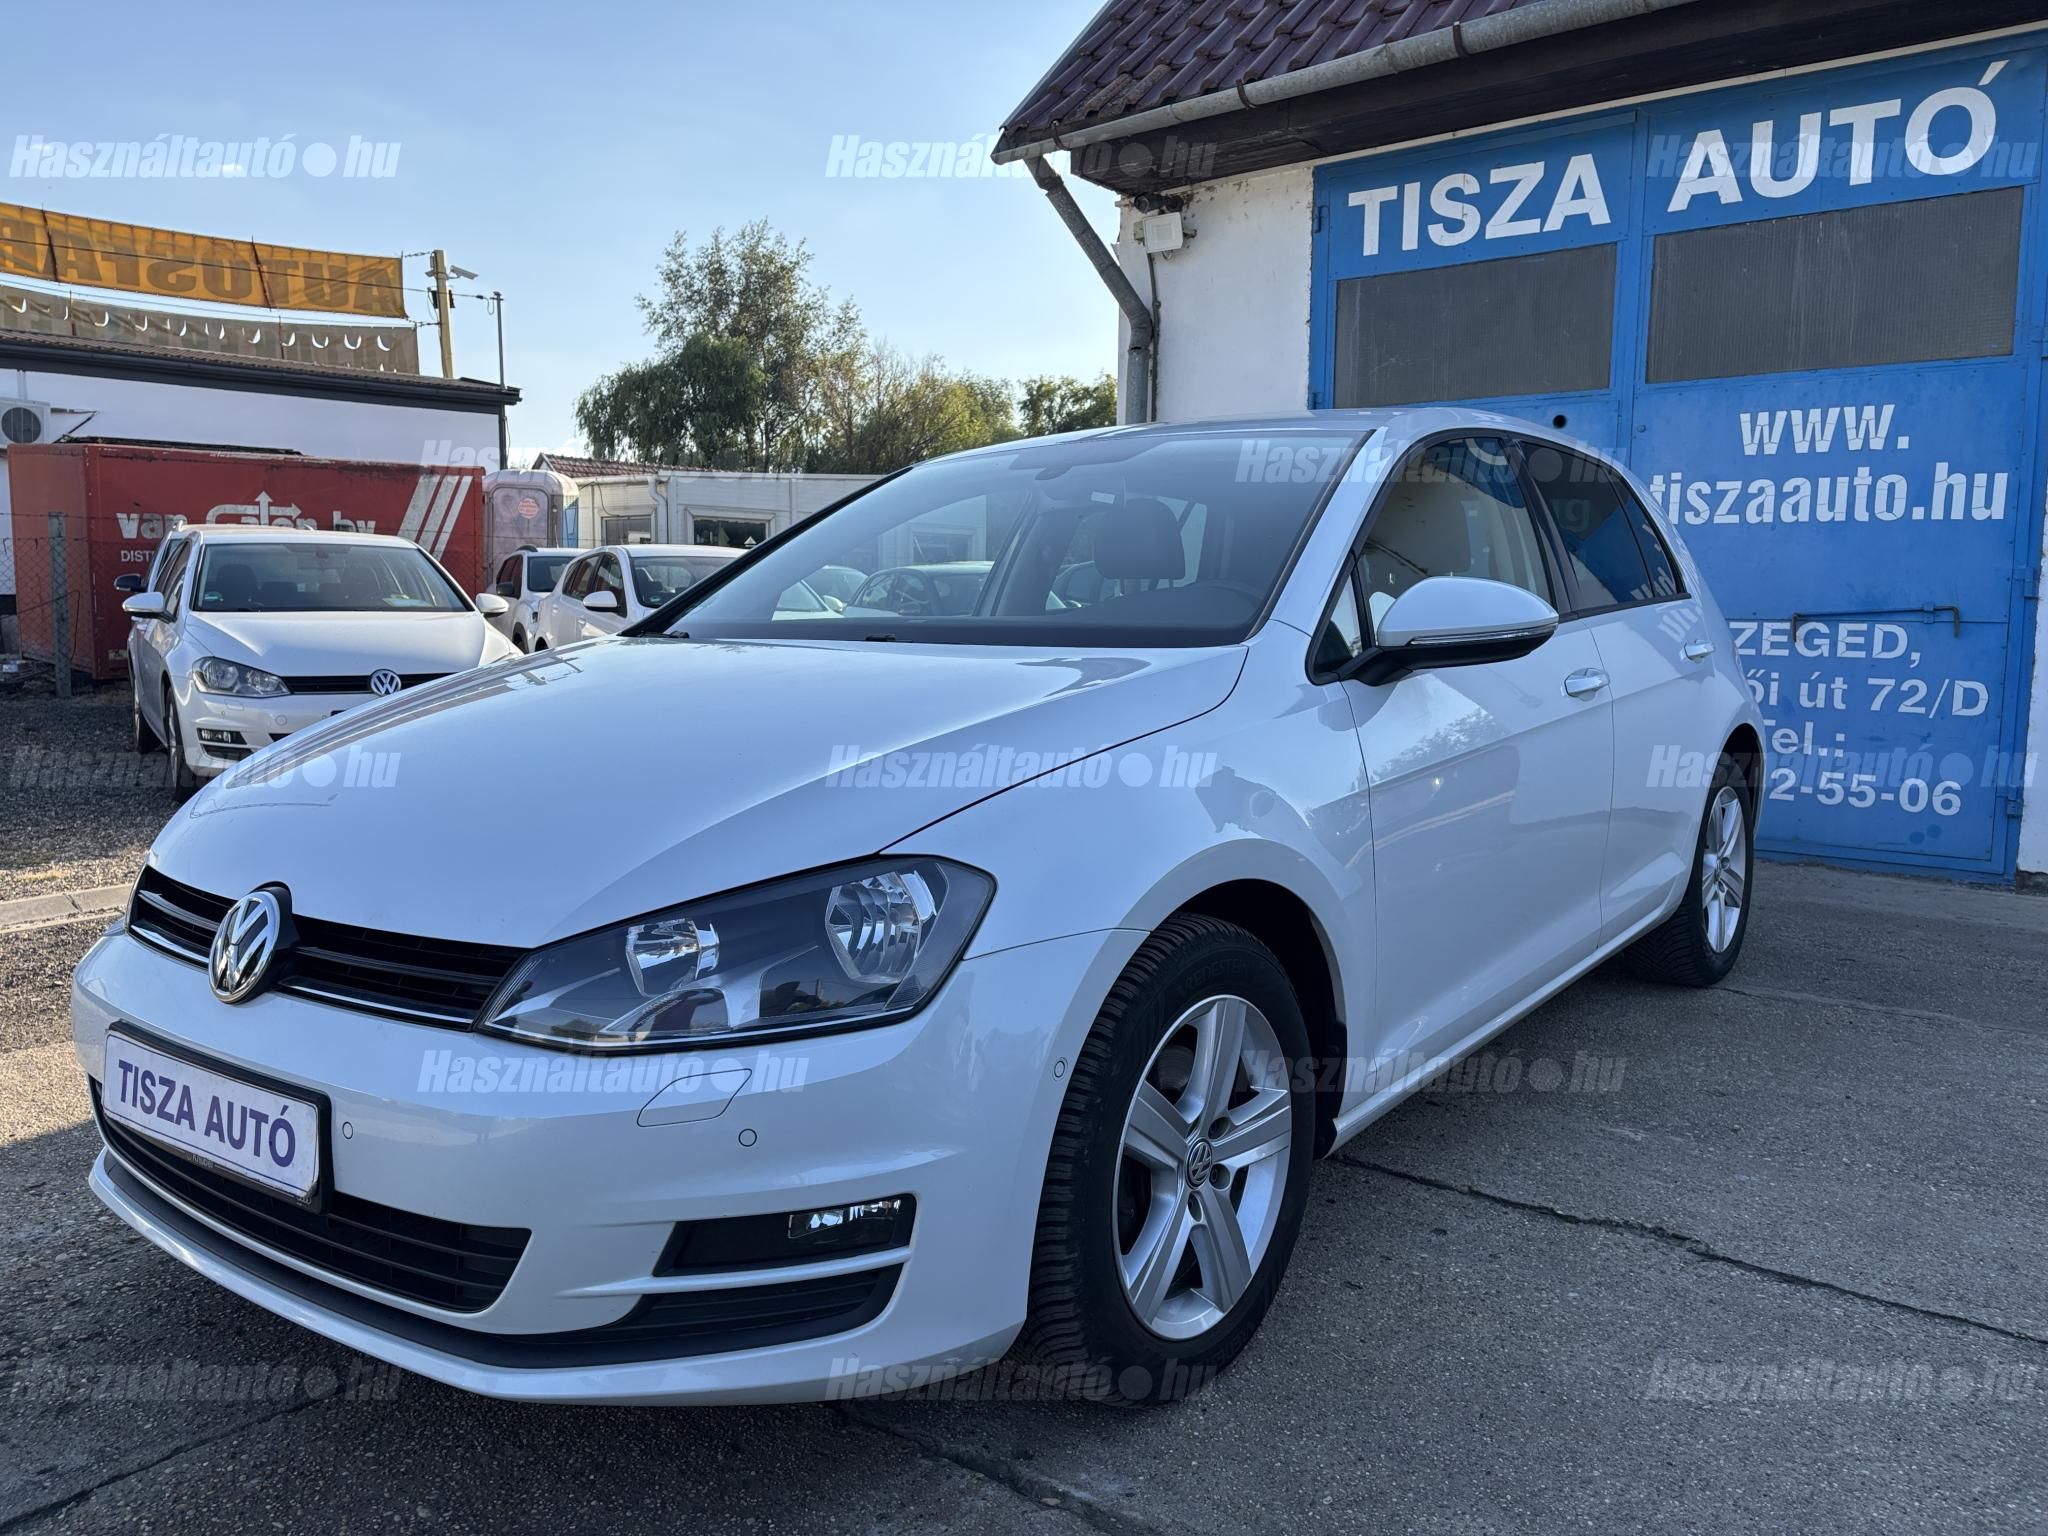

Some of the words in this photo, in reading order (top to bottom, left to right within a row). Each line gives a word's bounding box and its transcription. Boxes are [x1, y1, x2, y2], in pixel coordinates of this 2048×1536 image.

[1348, 154, 1611, 256] TISZA
[1667, 60, 2010, 212] AUTÓ
[1739, 404, 1910, 456] www.
[1650, 462, 2008, 525] tiszaauto.hu
[120, 550, 154, 563] DIST
[1729, 621, 1921, 668] ZEGED,
[1799, 671, 1848, 711] út
[1867, 677, 1989, 719] 72/D
[1769, 767, 1962, 817] 2-55-06
[118, 1059, 196, 1132] TISZA
[204, 1104, 296, 1168] AUTÓ
